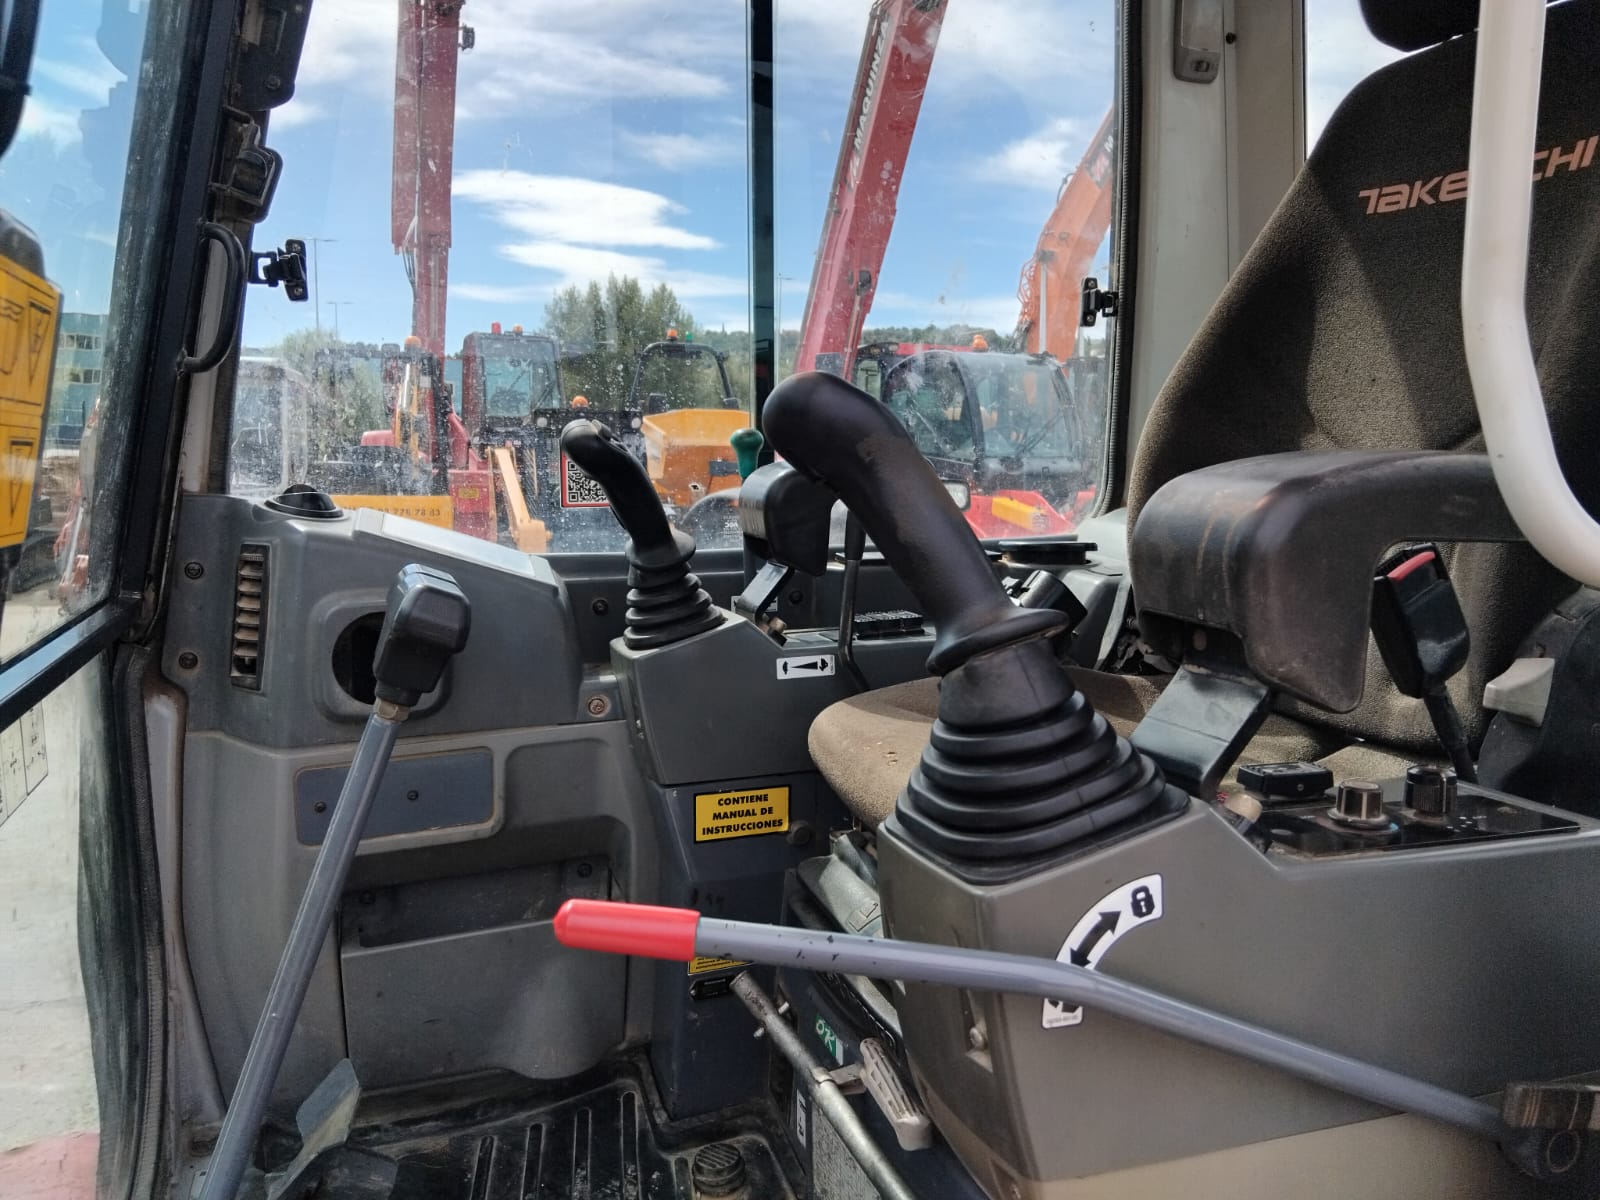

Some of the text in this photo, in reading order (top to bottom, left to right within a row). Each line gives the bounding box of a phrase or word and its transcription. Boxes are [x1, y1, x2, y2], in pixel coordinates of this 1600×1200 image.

[854, 21, 889, 150] MAQUINZA
[1358, 136, 1599, 215] TAKECHI
[718, 794, 769, 806] CONTIENE
[712, 806, 774, 821] MANUAL DE
[702, 819, 783, 835] INSTRUCCIONES
